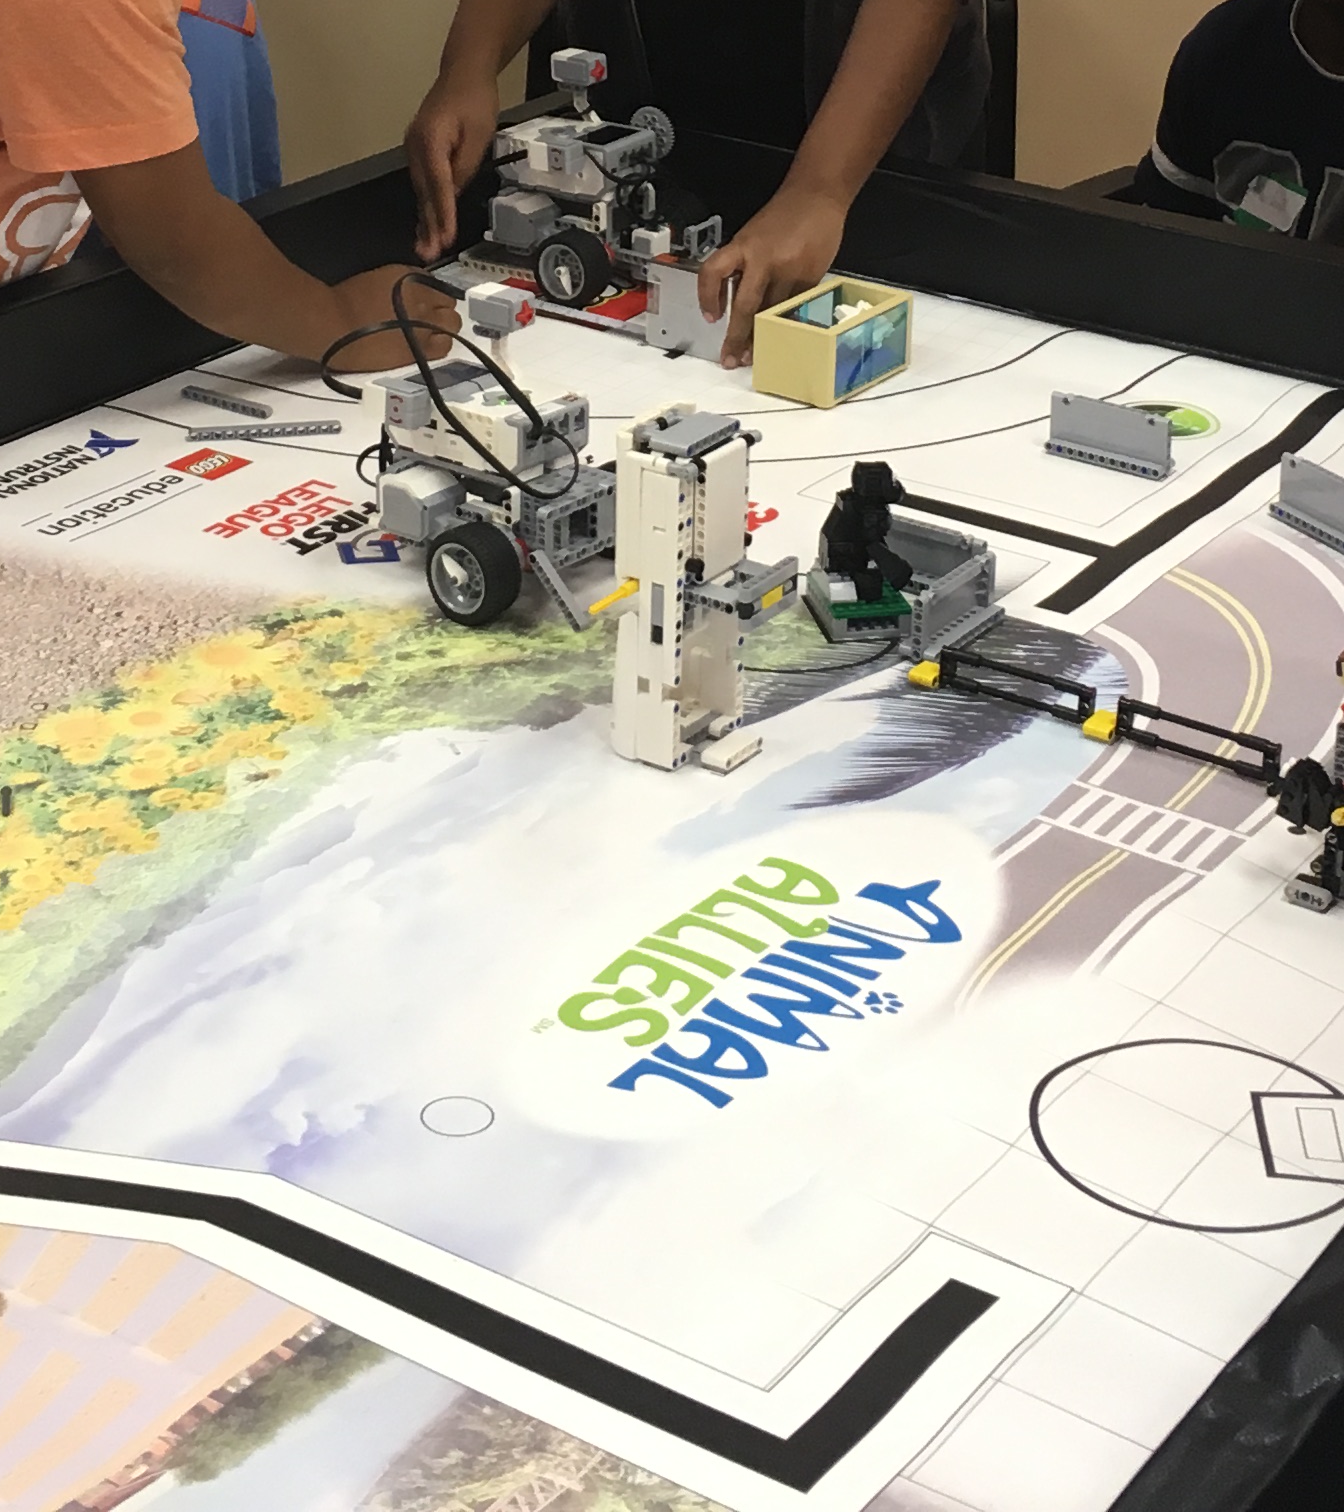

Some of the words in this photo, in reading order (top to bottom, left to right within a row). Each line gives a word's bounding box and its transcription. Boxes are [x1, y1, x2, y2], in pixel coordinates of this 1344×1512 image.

[186, 454, 231, 476] LEGO
[37, 474, 184, 536] education
[203, 479, 338, 539] LEAGUE
[260, 495, 353, 538] LEGO
[557, 857, 840, 1048] ALLIES
[607, 879, 963, 1109] ANIMAL
